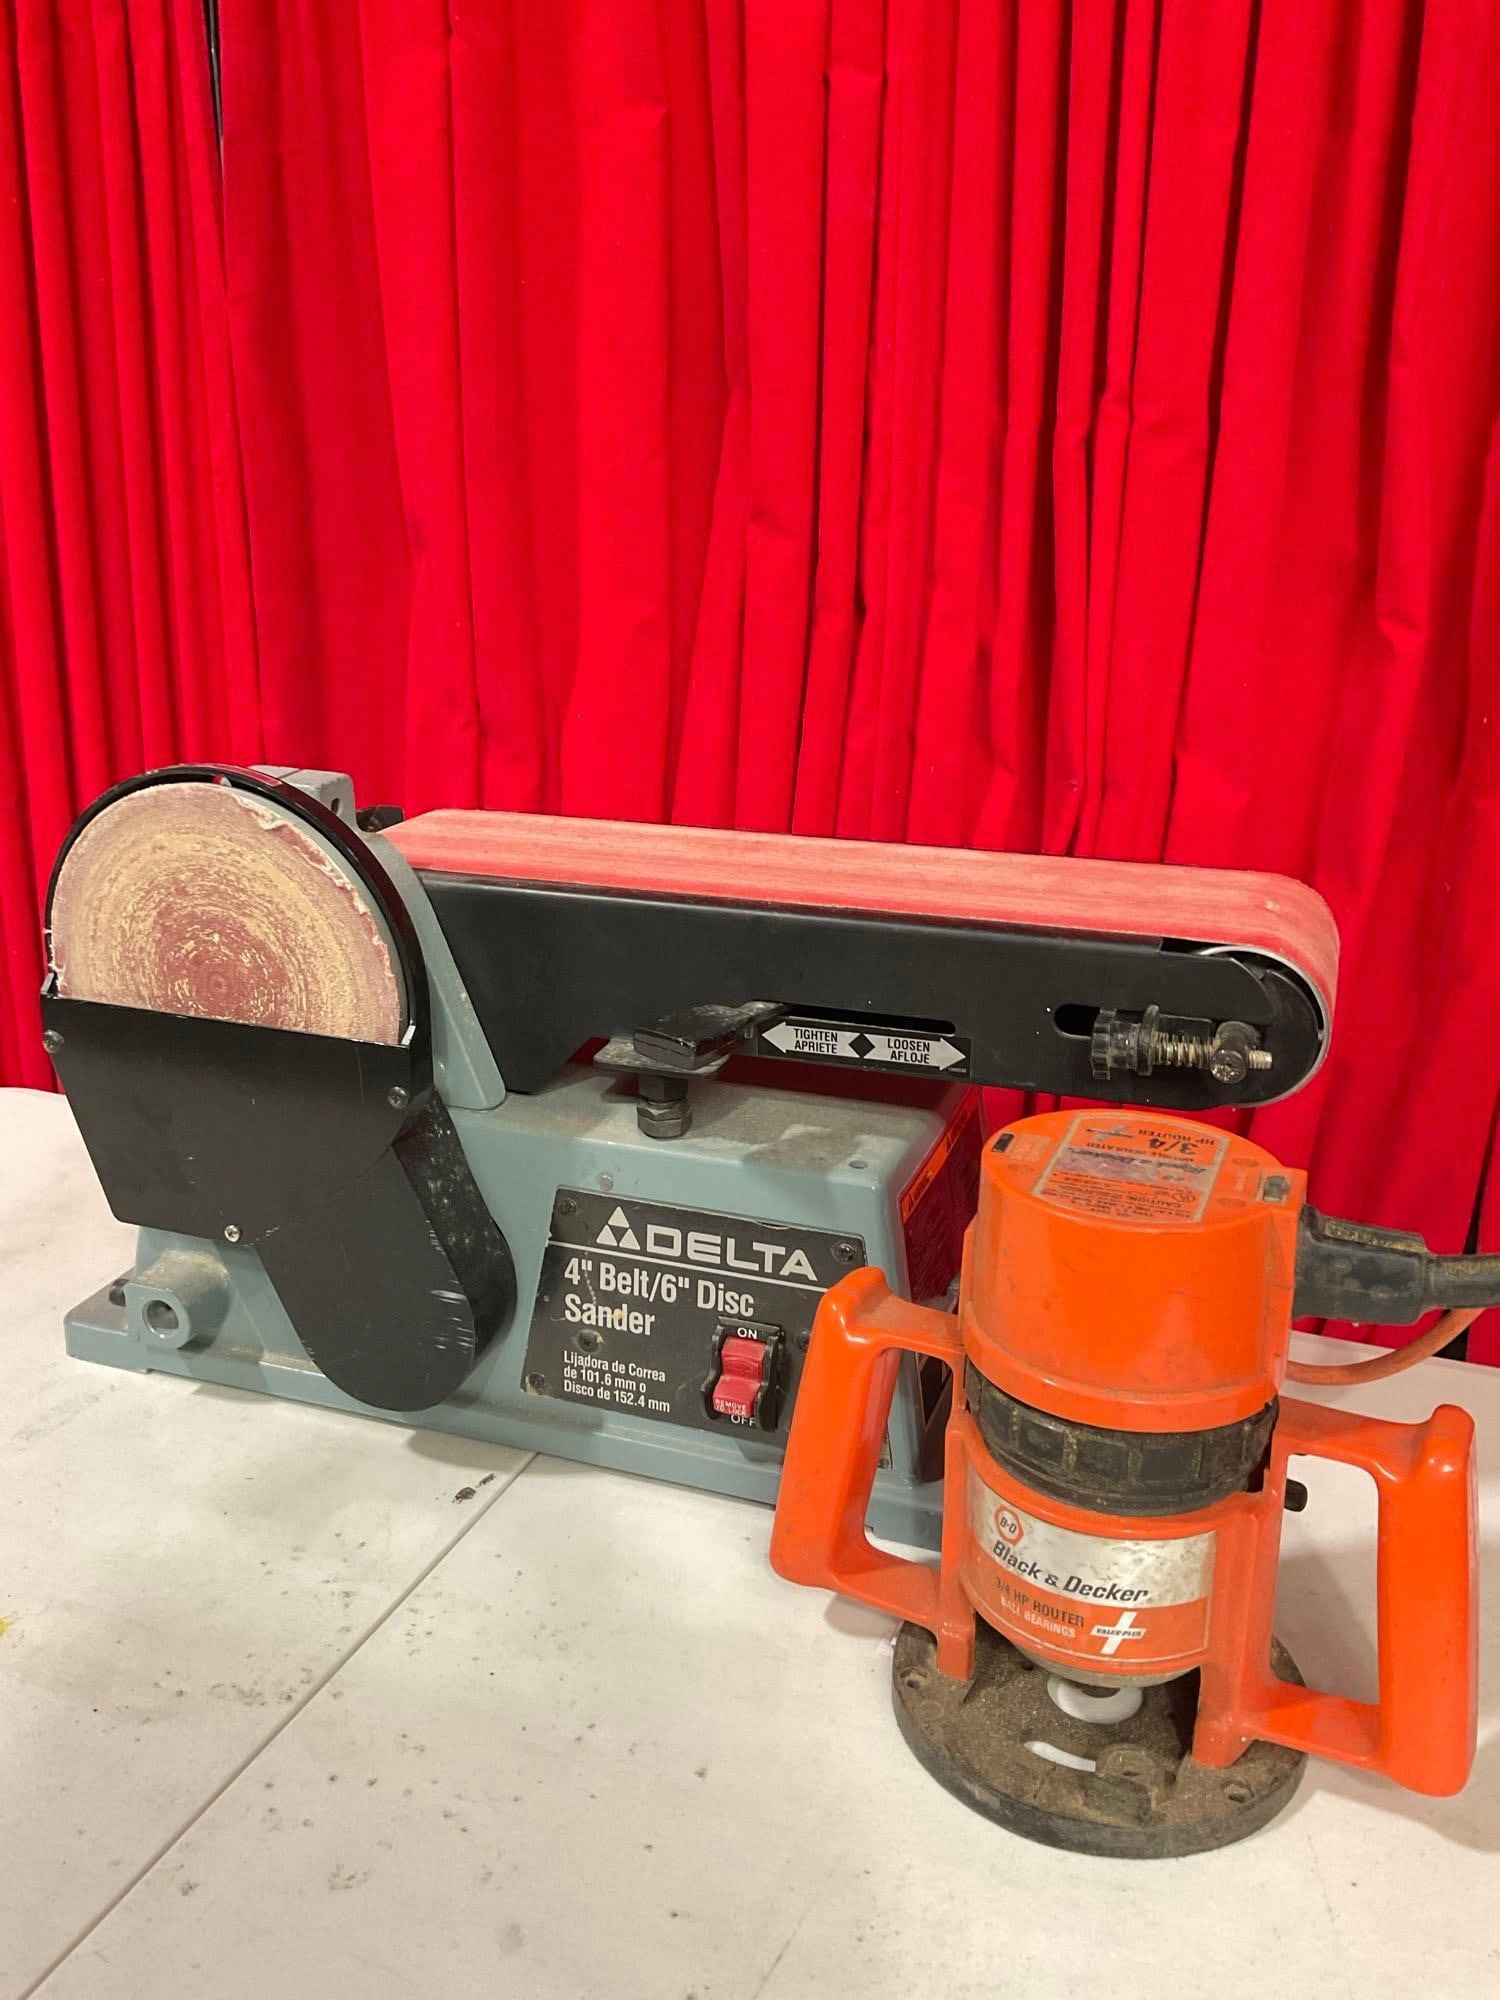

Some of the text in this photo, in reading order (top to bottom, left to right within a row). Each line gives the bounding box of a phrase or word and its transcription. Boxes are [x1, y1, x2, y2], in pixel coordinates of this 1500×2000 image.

[794, 1028, 838, 1043] TIGHTEN
[794, 1040, 837, 1054] APRIETE
[887, 1038, 930, 1052] LOOSEN
[890, 1052, 930, 1064] AFLOJE
[1138, 1129, 1193, 1142] ROUTER
[1195, 1138, 1215, 1146] HP
[1149, 1139, 1199, 1156] 3/4
[646, 1224, 818, 1281] DELTA
[564, 1257, 754, 1317] 4" Belt/6" Disc
[564, 1293, 656, 1336] Sander
[737, 1327, 757, 1339] ON
[564, 1350, 666, 1382] Lijadora de Correa
[564, 1366, 647, 1393] de 101.6 mm o
[564, 1379, 671, 1412] Disco de 152.4 mm
[716, 1400, 746, 1411] REMOVE
[728, 1407, 747, 1416] LOCK
[730, 1414, 756, 1427] OFF
[992, 1540, 1149, 1602] Black & Decker
[1014, 1590, 1029, 1605] HP
[1033, 1600, 1085, 1627] ROUTER
[1024, 1612, 1077, 1638] BEARINGS
